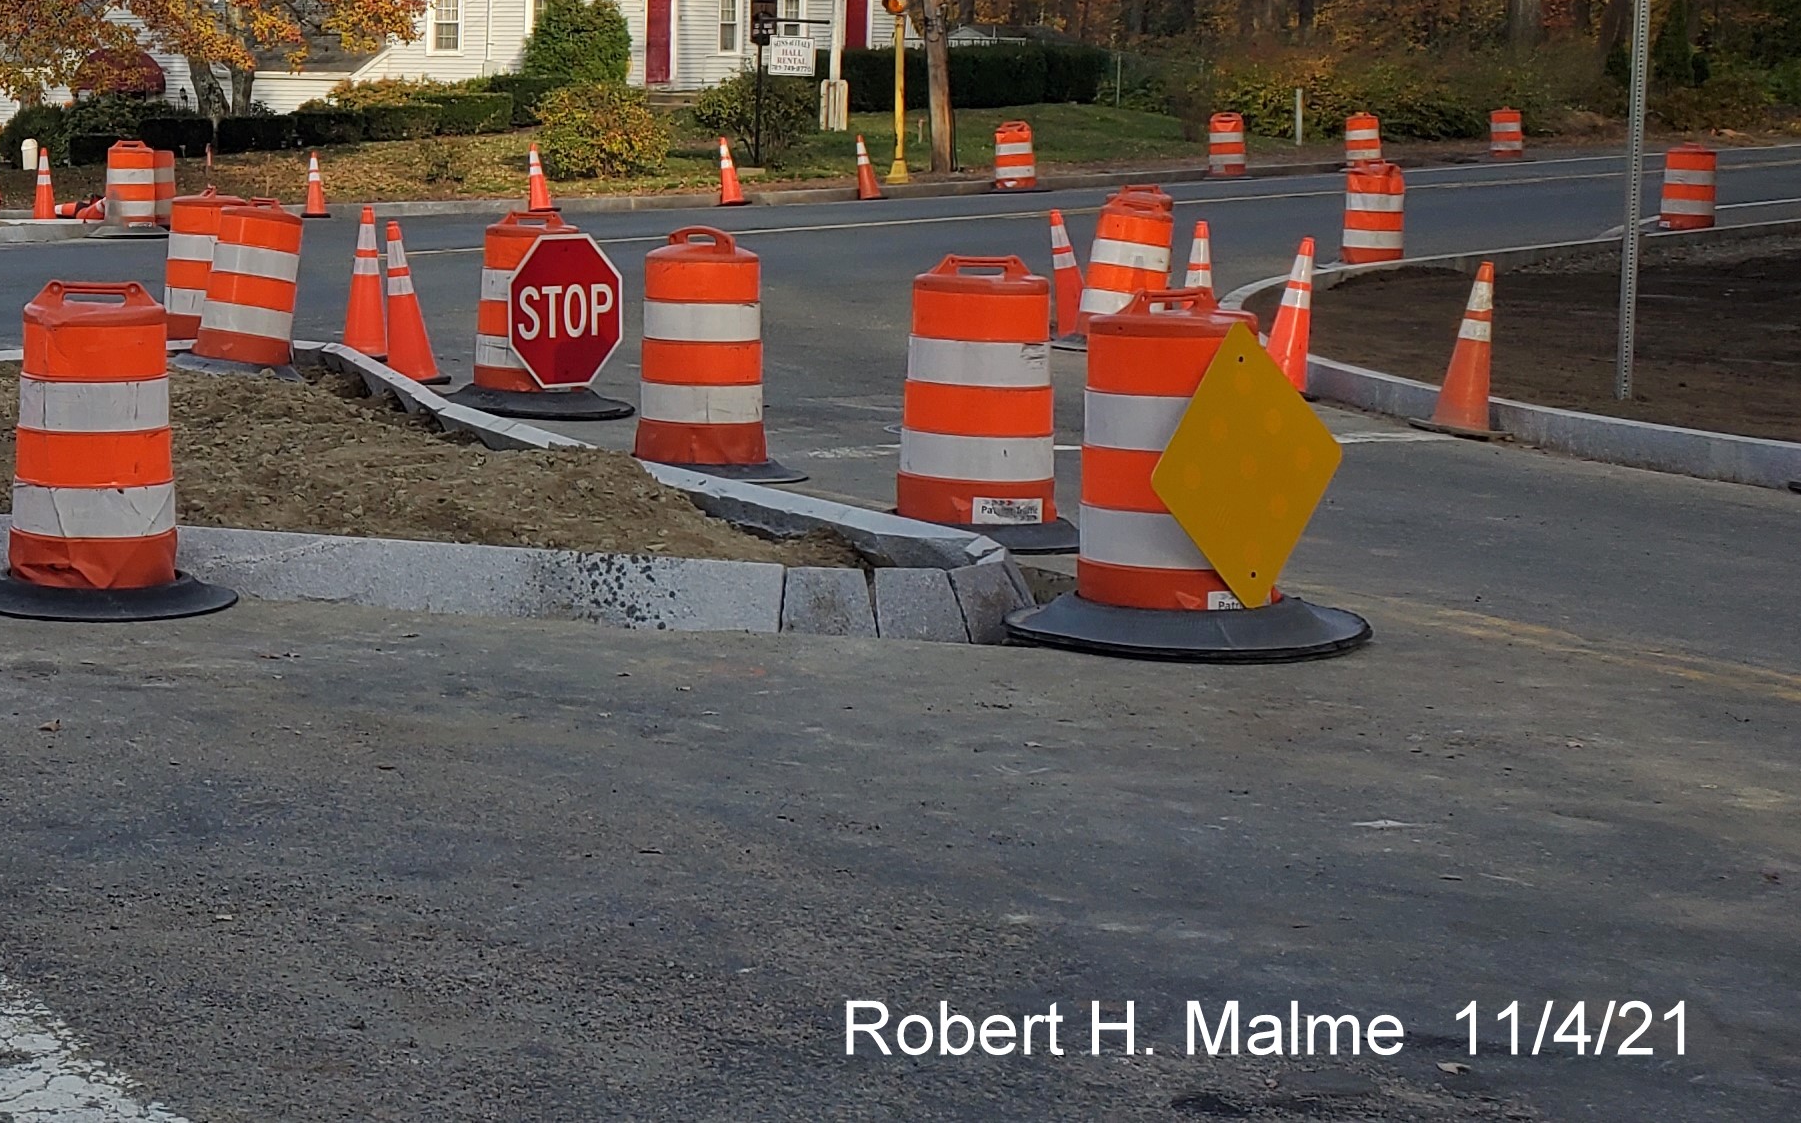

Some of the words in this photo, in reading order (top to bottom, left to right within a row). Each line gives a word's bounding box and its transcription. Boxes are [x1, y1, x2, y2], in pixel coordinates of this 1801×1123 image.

[781, 48, 803, 57] HALL
[776, 56, 807, 66] RENTAL
[517, 283, 613, 341] STOP
